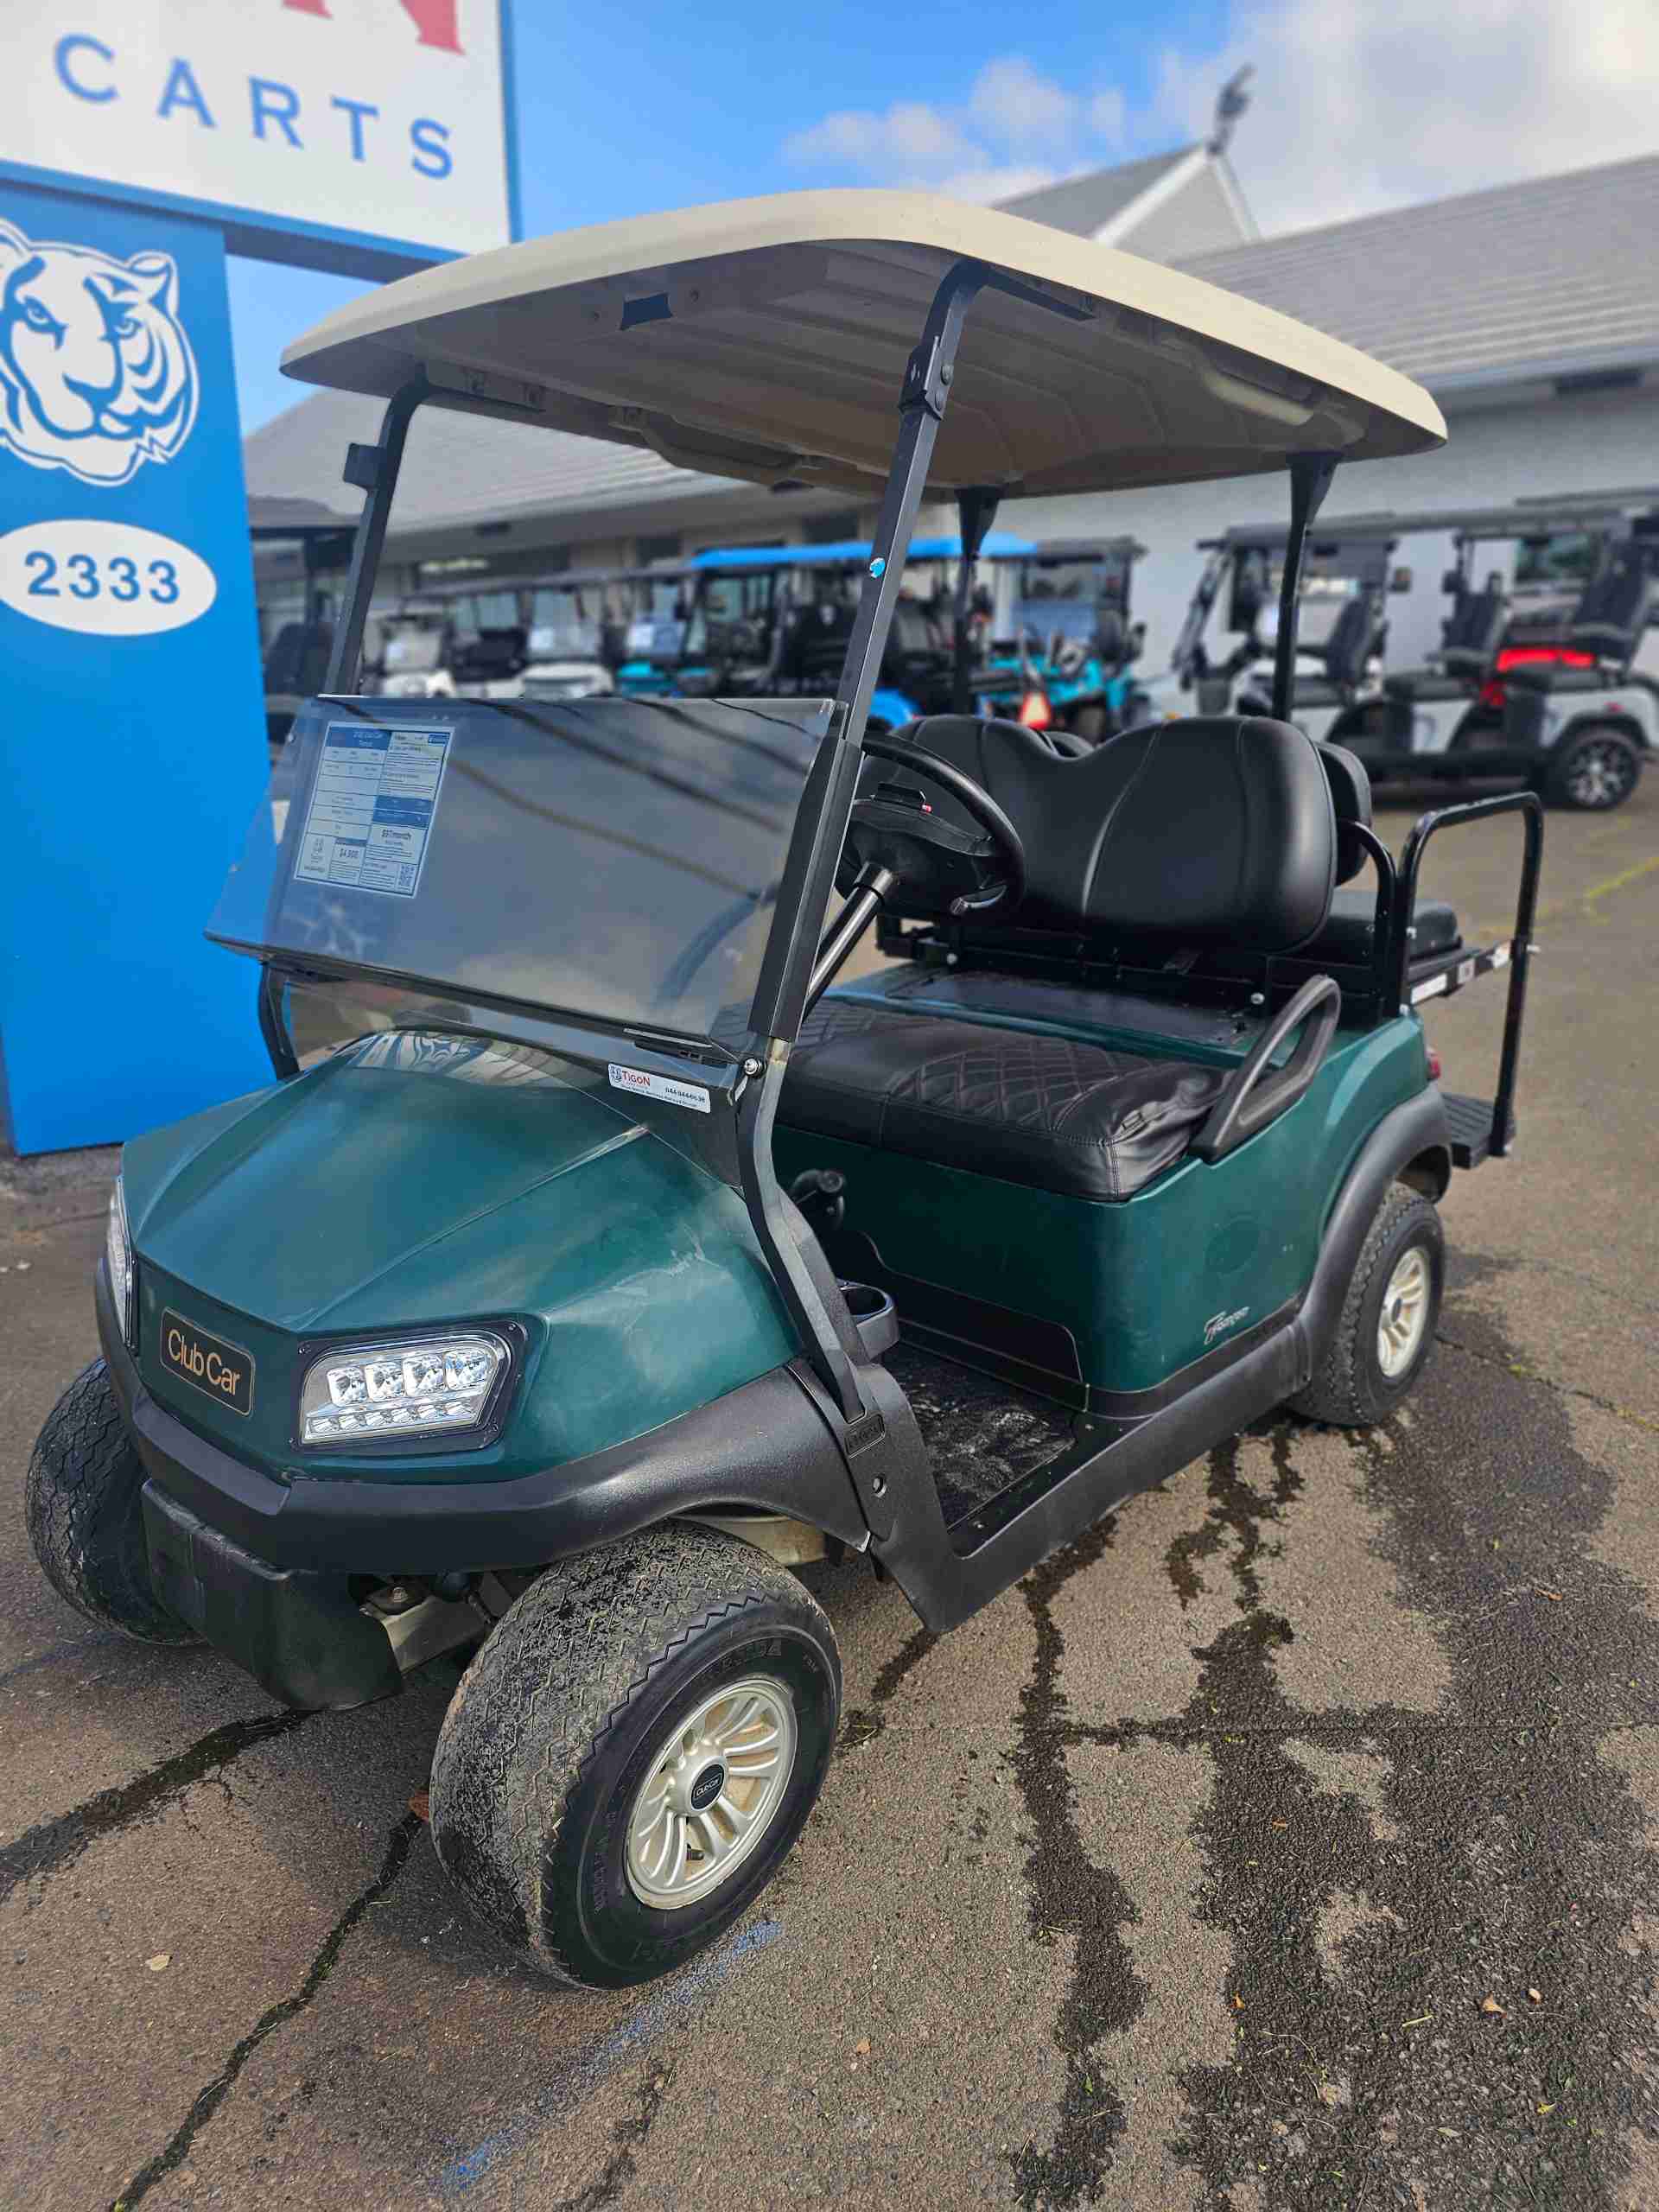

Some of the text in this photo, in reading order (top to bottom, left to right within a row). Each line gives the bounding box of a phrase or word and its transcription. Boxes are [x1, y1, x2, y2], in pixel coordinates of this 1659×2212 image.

[54, 34, 454, 180] CARTS
[25, 550, 180, 605] 2333
[168, 1329, 240, 1395] Club Car
